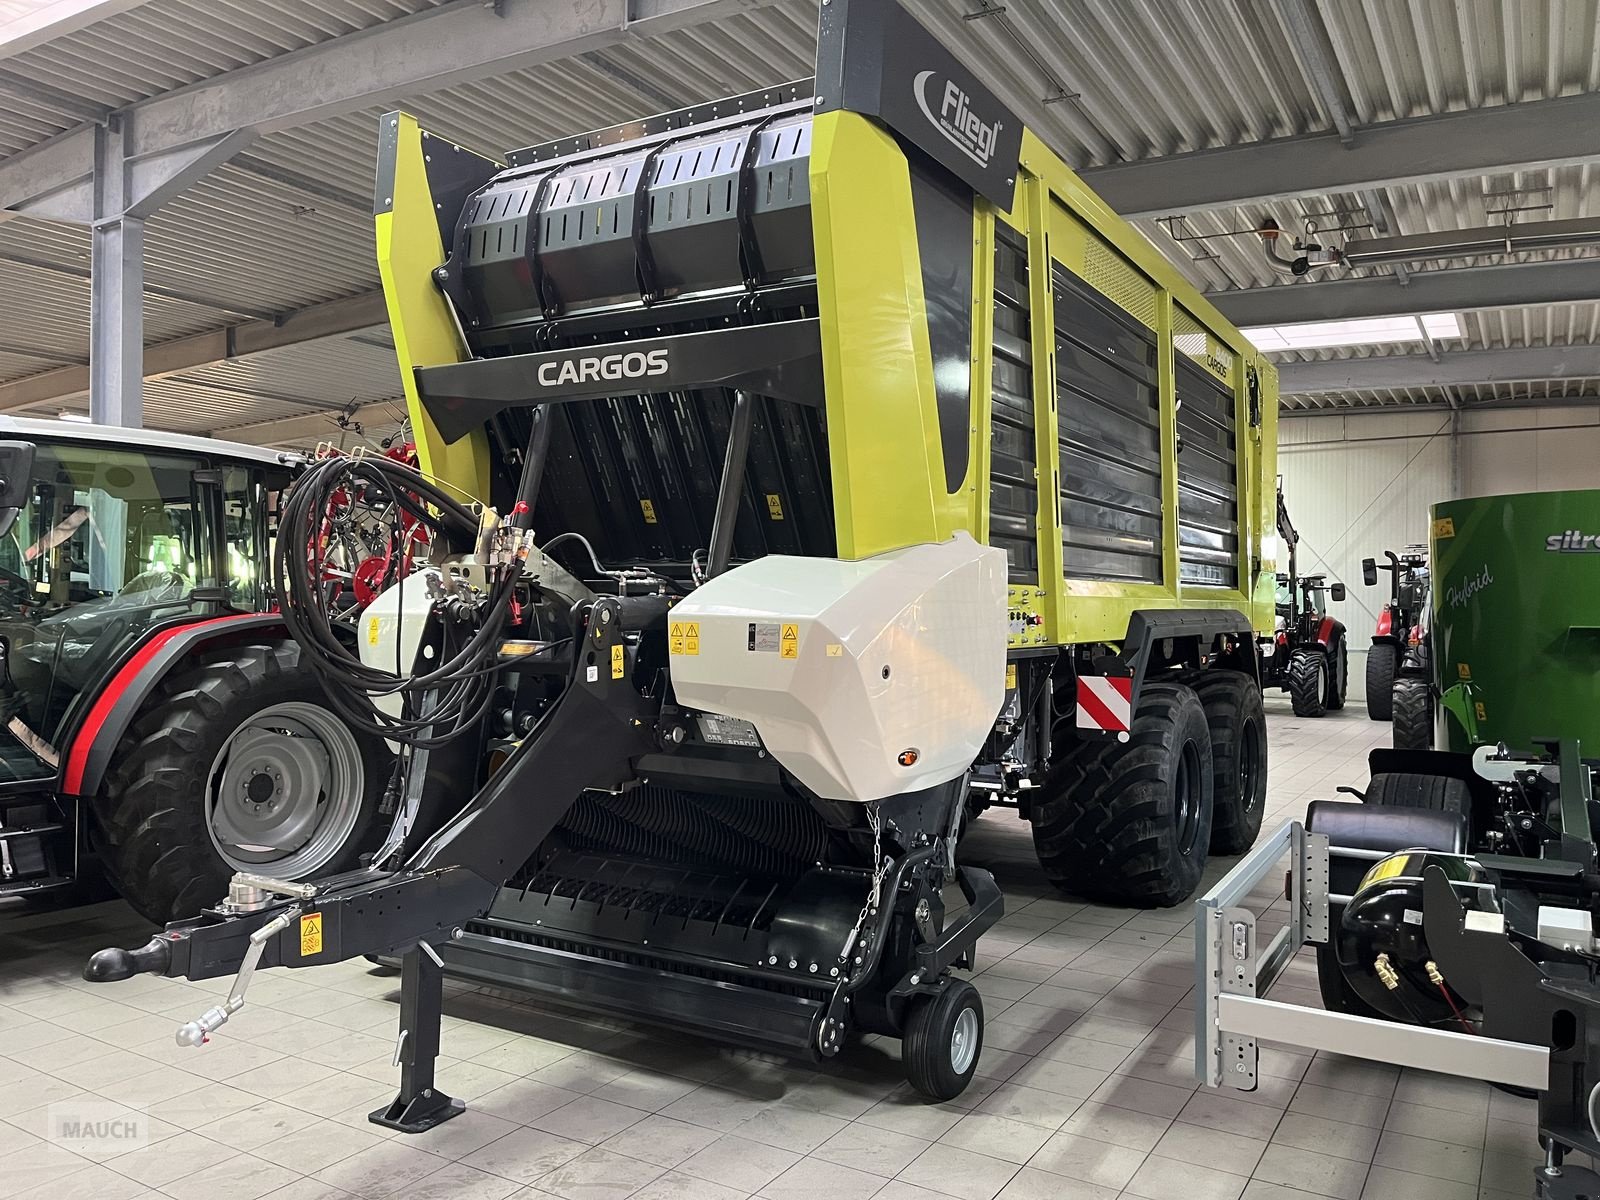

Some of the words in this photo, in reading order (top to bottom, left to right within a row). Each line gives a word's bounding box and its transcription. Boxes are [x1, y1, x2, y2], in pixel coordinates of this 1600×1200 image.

[941, 79, 999, 162] Fliegl
[537, 349, 669, 387] CARGOS
[1206, 354, 1227, 378] CARGOS
[1446, 563, 1494, 609] Hybrid
